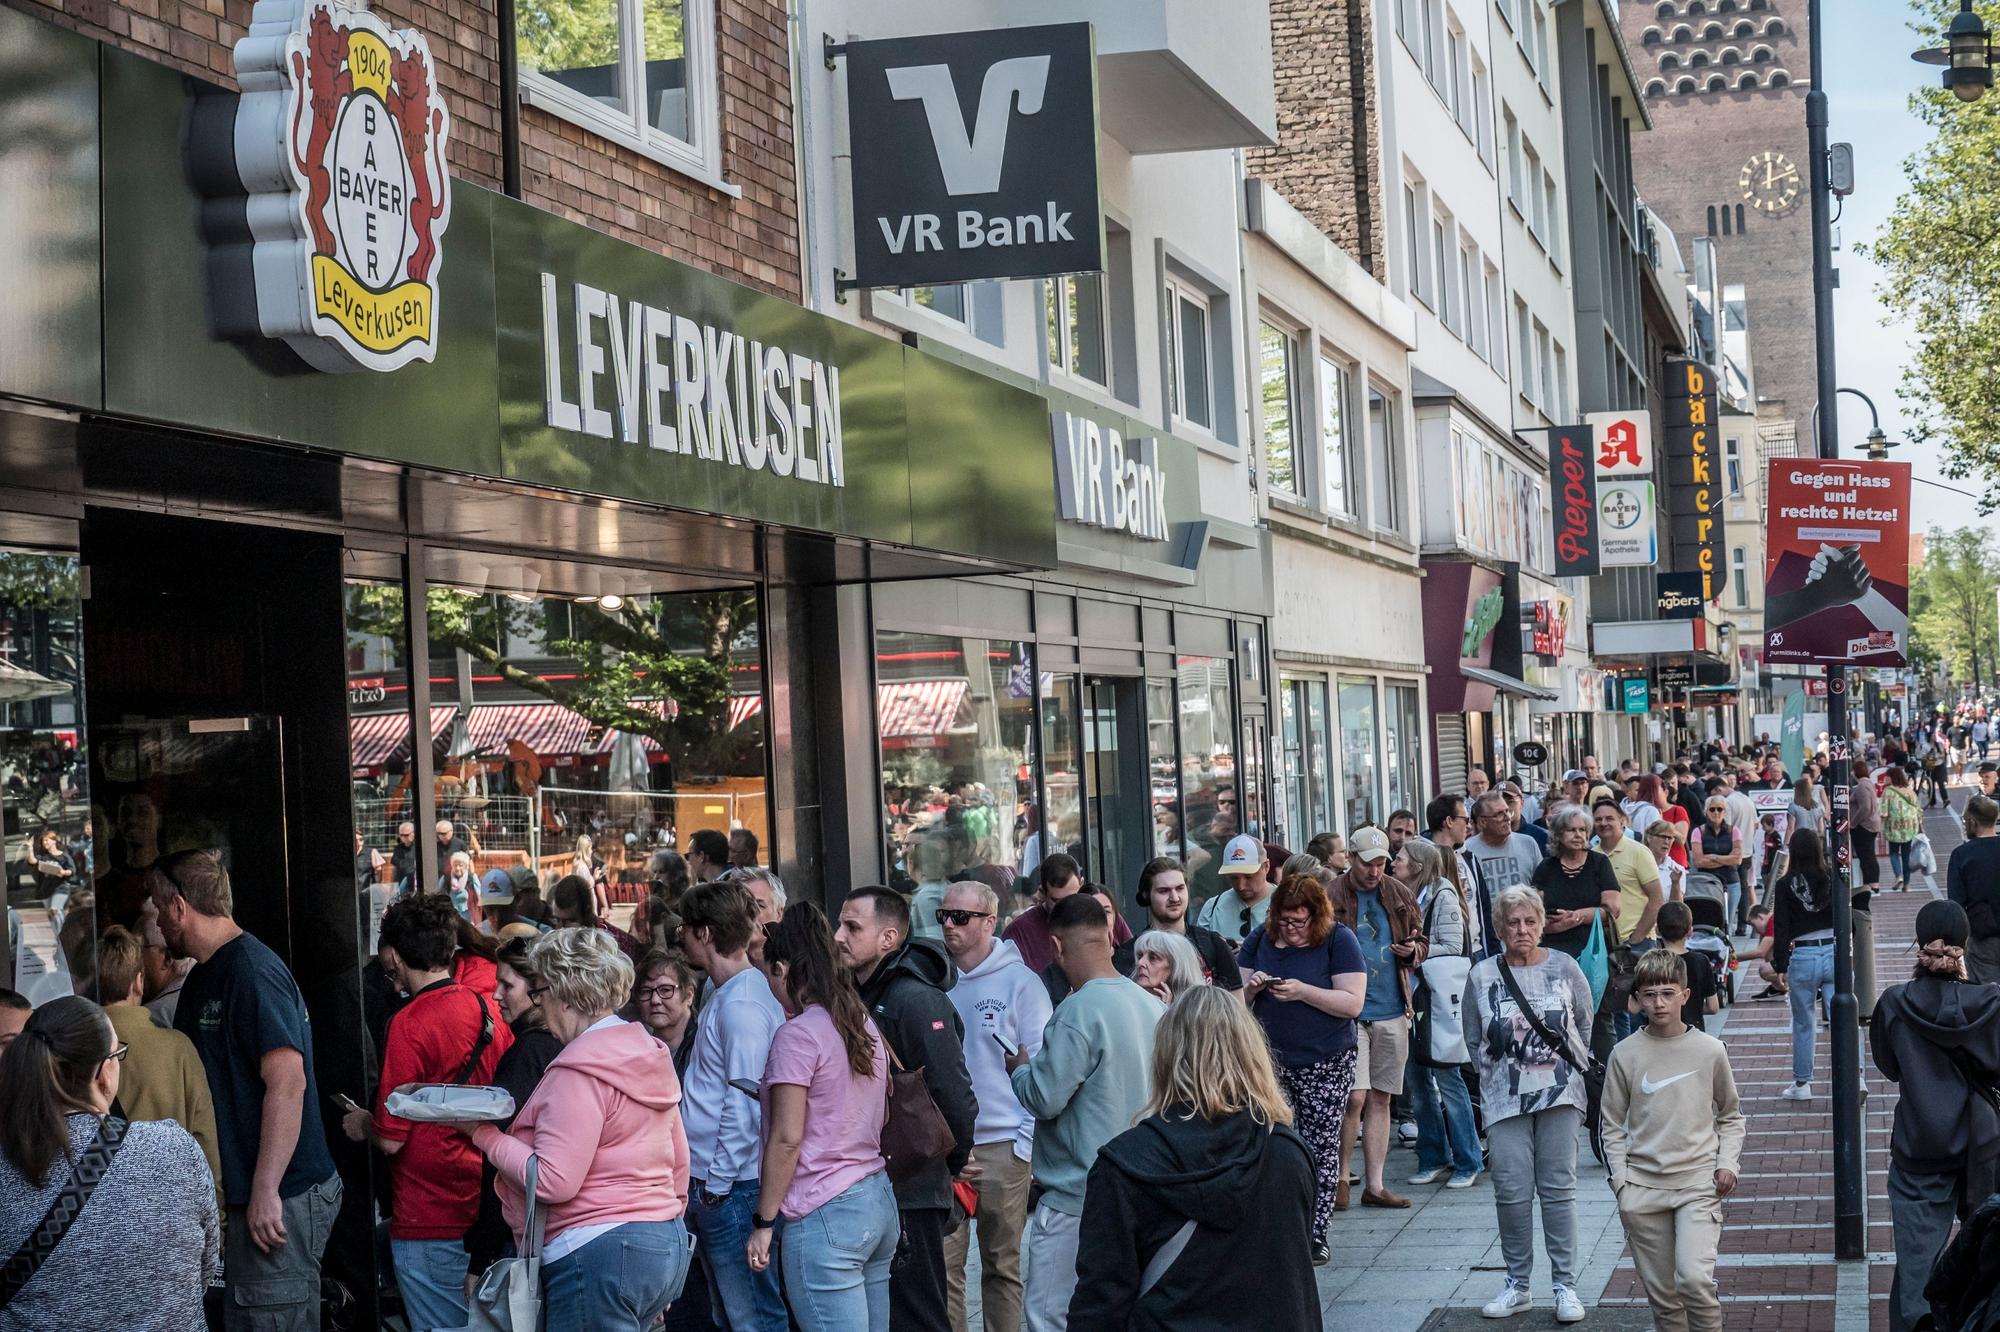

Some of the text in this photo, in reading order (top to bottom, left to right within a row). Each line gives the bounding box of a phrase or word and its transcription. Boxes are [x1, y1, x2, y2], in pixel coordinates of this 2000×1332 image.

[353, 45, 387, 85] 1904
[339, 166, 403, 216] BAYER
[364, 104, 379, 281] BAYER
[877, 201, 1075, 254] VR Bank
[321, 265, 423, 340] Leverkusen
[541, 272, 845, 487] LEVERKUSEN
[1062, 410, 1170, 542] VR Bank
[1686, 365, 1713, 600] bäckerei
[1789, 471, 1891, 489] Gegen Hass
[1823, 489, 1857, 503] und
[1558, 437, 1592, 563] Pieper
[1603, 505, 1637, 513] BAYER
[1780, 505, 1898, 521] rechte Hetze!
[1657, 594, 1700, 609] ngbers
[1851, 643, 1868, 653] Die
[974, 999, 1007, 1011] HILFIGER
